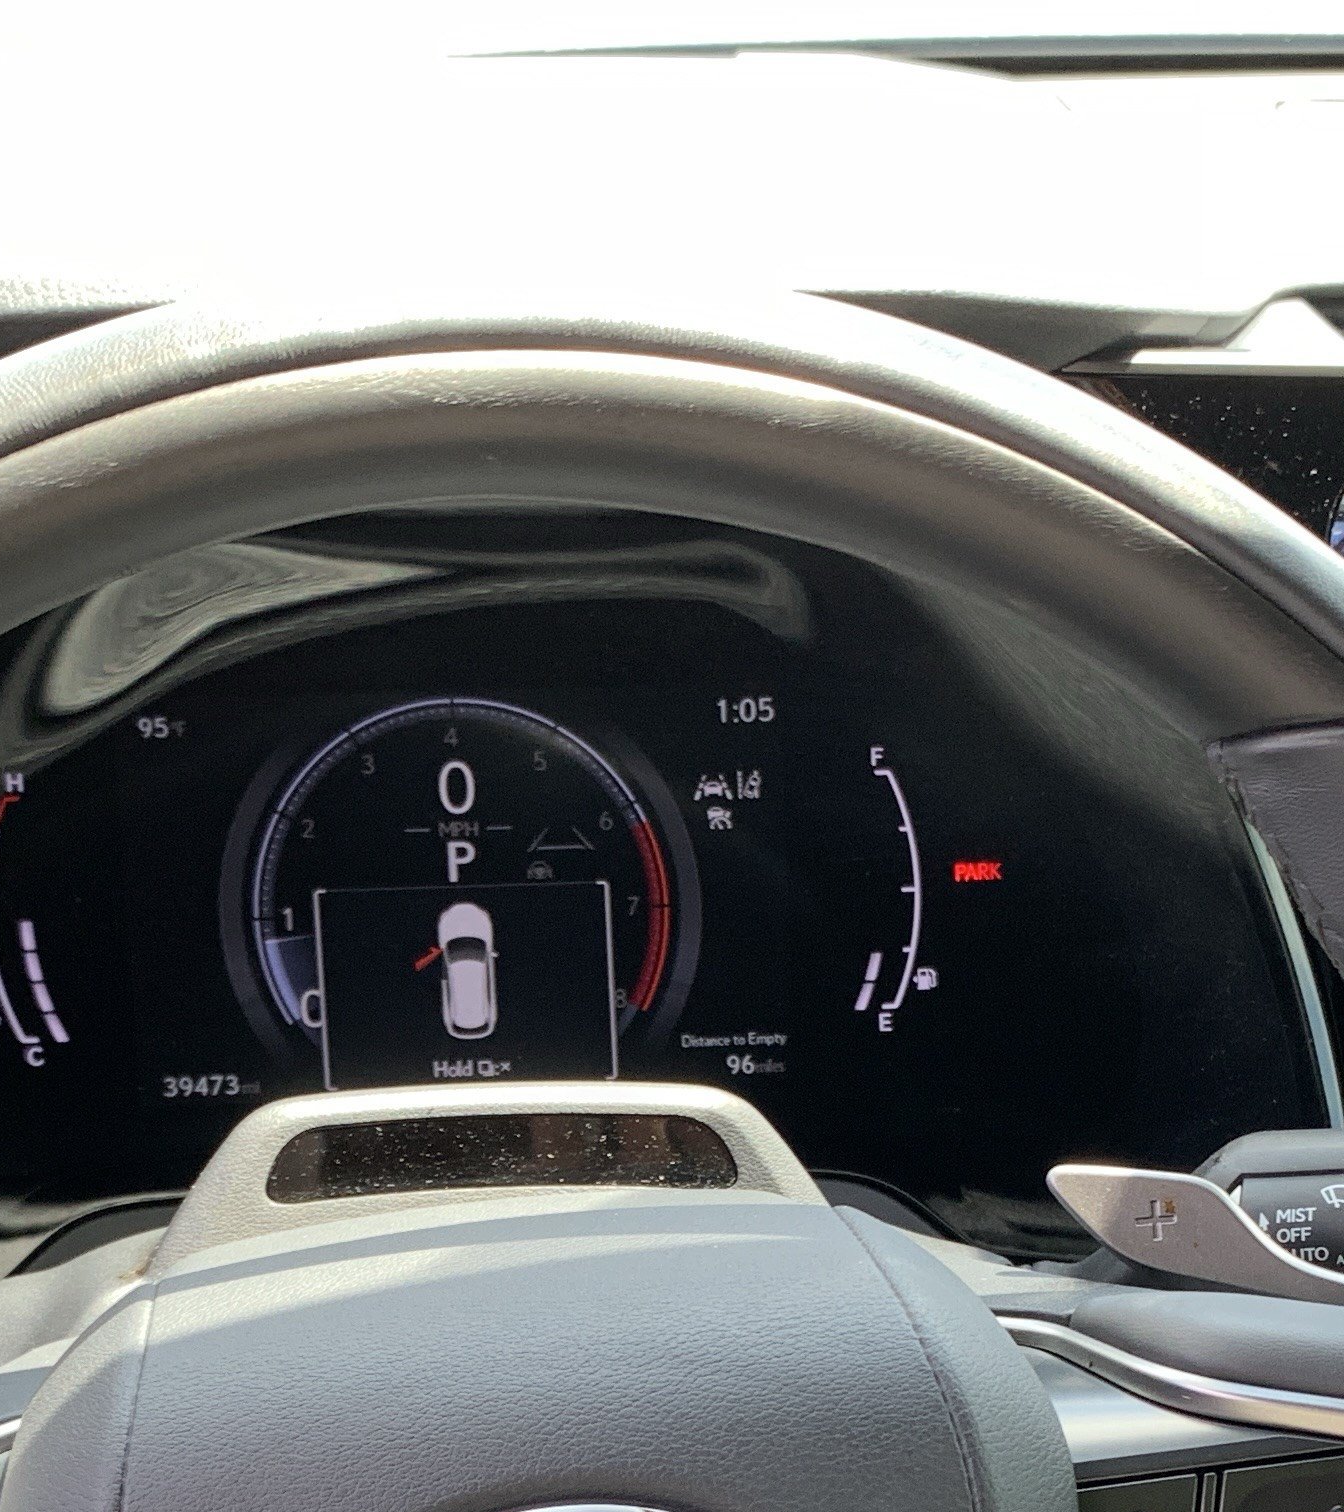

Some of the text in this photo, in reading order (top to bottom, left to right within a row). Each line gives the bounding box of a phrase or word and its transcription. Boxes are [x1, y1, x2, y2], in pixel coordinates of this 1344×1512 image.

[716, 697, 775, 723] 1:05
[443, 728, 458, 748] 4
[361, 754, 376, 775] 3
[533, 751, 547, 771] 5
[870, 747, 884, 767] F
[4, 773, 25, 794] H
[437, 759, 476, 815] 0
[301, 818, 316, 838] 2
[437, 822, 479, 837] MPH
[599, 811, 613, 831] 6
[446, 841, 476, 883] P
[954, 861, 1003, 883] PARK
[627, 896, 640, 917] 7
[282, 908, 294, 931] 1
[615, 988, 628, 1009] 8
[879, 1013, 894, 1033] E
[680, 1032, 787, 1049] Distance to Empty
[26, 1046, 46, 1067] C
[726, 1054, 755, 1075] 96
[432, 1060, 474, 1078] Hold
[162, 1073, 241, 1098] 39473
[1276, 1207, 1318, 1223] MIST
[1276, 1227, 1312, 1243] OFF
[1292, 1247, 1330, 1261] UTO
